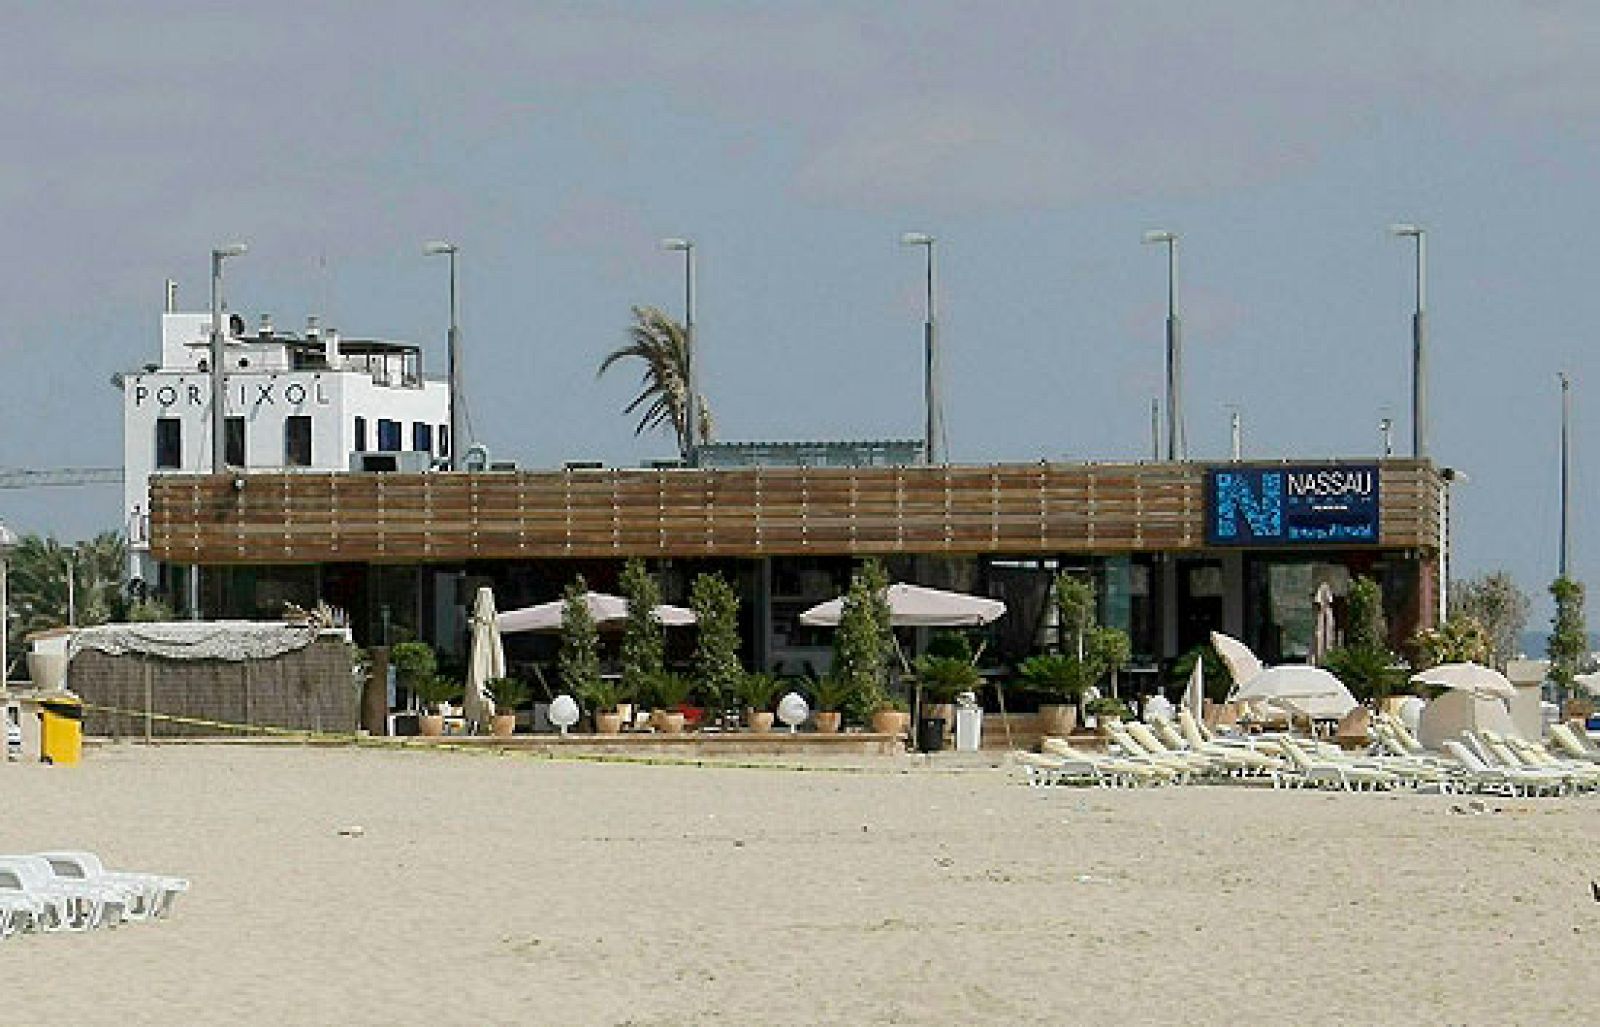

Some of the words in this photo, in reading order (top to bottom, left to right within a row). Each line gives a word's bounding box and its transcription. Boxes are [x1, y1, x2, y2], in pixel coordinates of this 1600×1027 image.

[136, 384, 329, 406] PORIXOL
[1288, 471, 1371, 496] NASSAU
[1217, 473, 1281, 536] N
